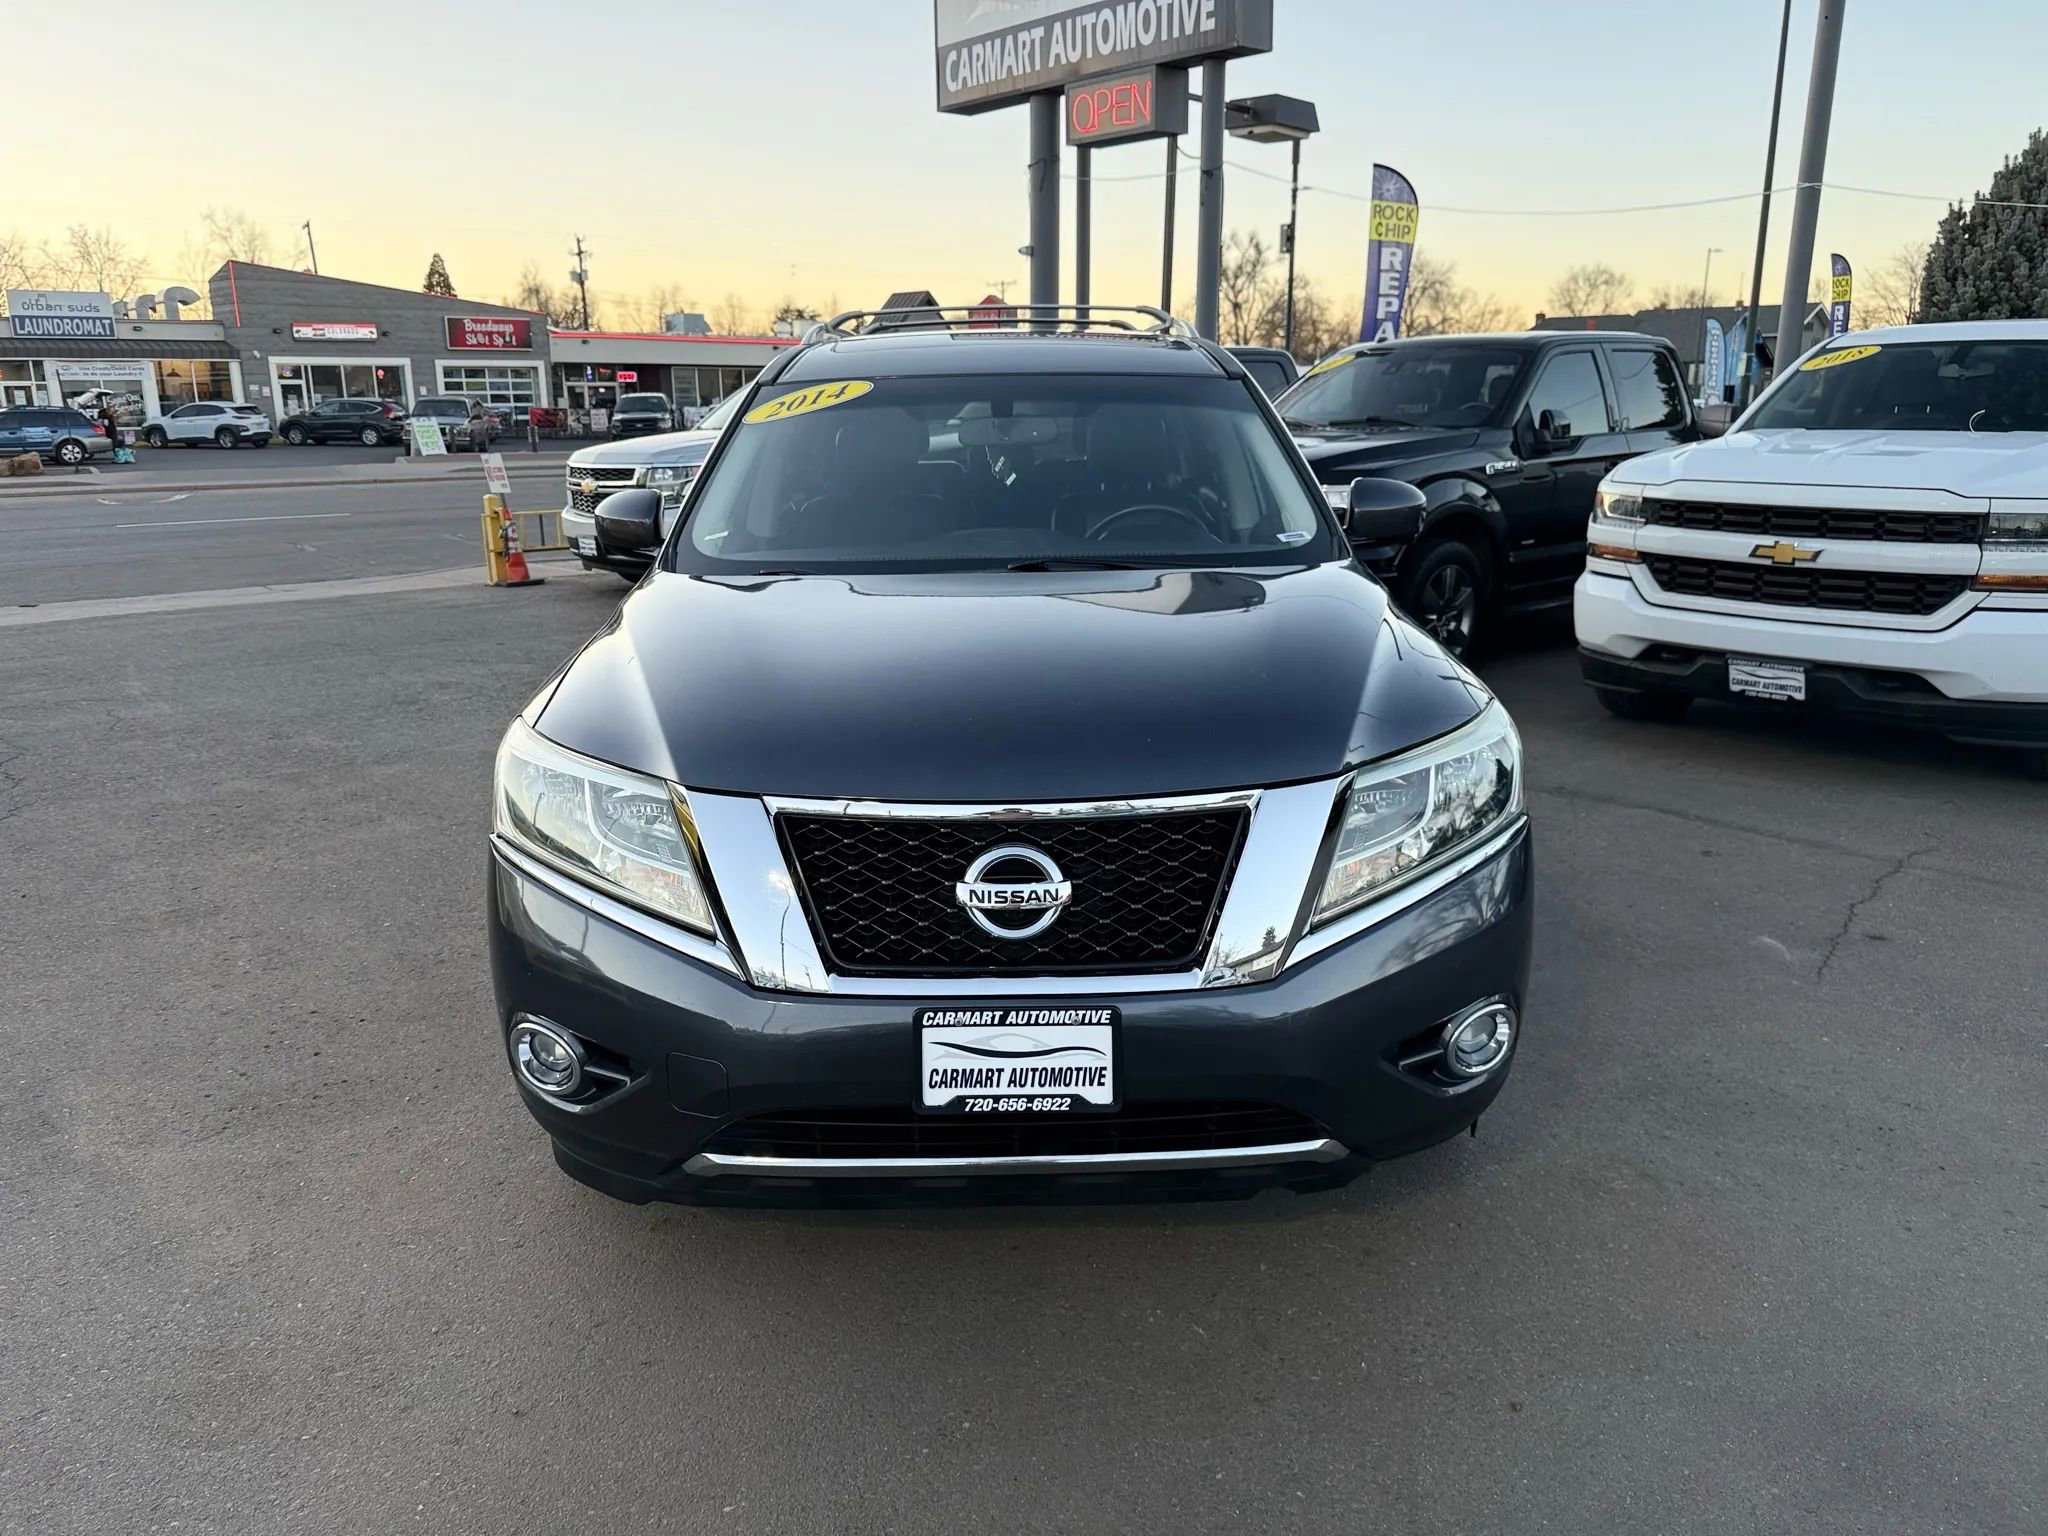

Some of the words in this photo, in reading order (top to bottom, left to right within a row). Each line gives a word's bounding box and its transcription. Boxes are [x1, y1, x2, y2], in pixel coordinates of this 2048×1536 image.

[945, 26, 1045, 93] CARMART
[1048, 0, 1216, 68] AUTOMOTIVE
[1071, 79, 1152, 133] OPEN
[1373, 203, 1415, 223] ROCK
[1375, 222, 1411, 239] CHIP
[67, 301, 100, 313] suds
[15, 317, 112, 335] LAUNDROMAT
[764, 383, 850, 419] 2014
[1731, 677, 1760, 688] CARMART
[1762, 681, 1803, 694] AUTOMOTIVE
[969, 888, 1059, 904] NISSAN
[922, 1011, 1003, 1026] CARMART
[1005, 1010, 1112, 1025] AUTOMOTIVE
[928, 1068, 1004, 1089] CARMART
[1007, 1066, 1108, 1088] AUTOMOTIVE
[964, 1098, 1071, 1112] 720-656-6922
